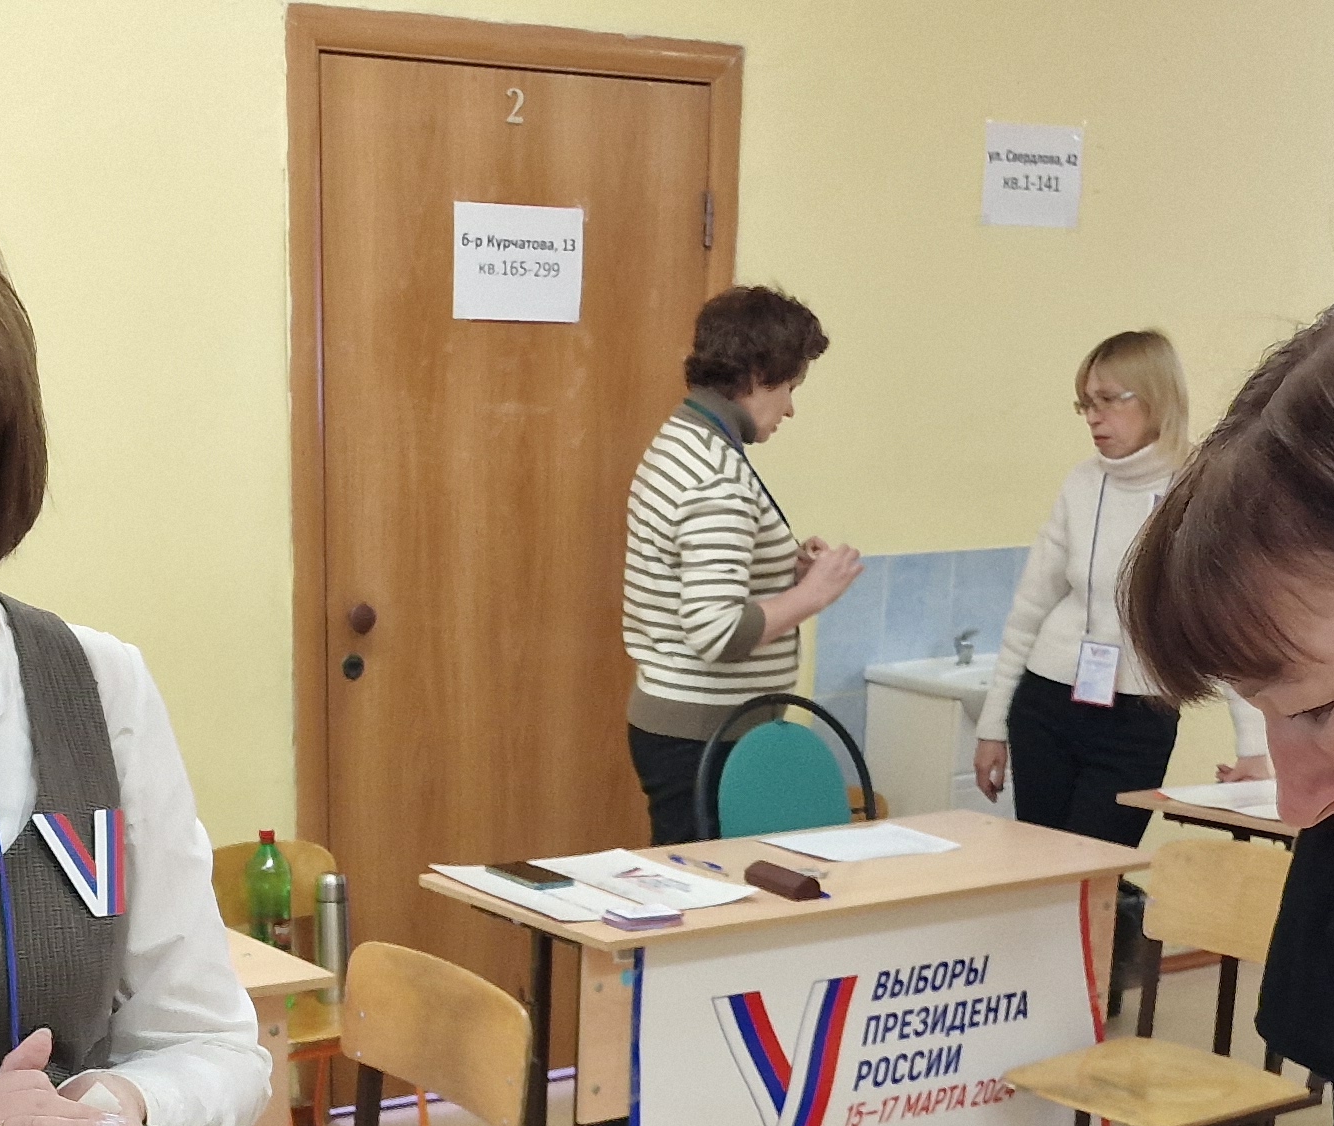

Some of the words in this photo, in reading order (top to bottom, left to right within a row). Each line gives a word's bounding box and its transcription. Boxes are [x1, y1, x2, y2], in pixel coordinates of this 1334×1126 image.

[505, 87, 525, 125] 2
[1002, 174, 1061, 192] кв.1-141
[461, 232, 483, 249] б-р
[486, 234, 559, 254] Курчатова,
[562, 238, 576, 253] 13
[478, 260, 561, 278] кв.165-299
[870, 954, 990, 1002] ВЫБОРЫ
[861, 990, 1029, 1047] ПРЕЗИДЕНТА
[852, 1043, 963, 1092] РОССИИ
[901, 1083, 968, 1119] МАРТА
